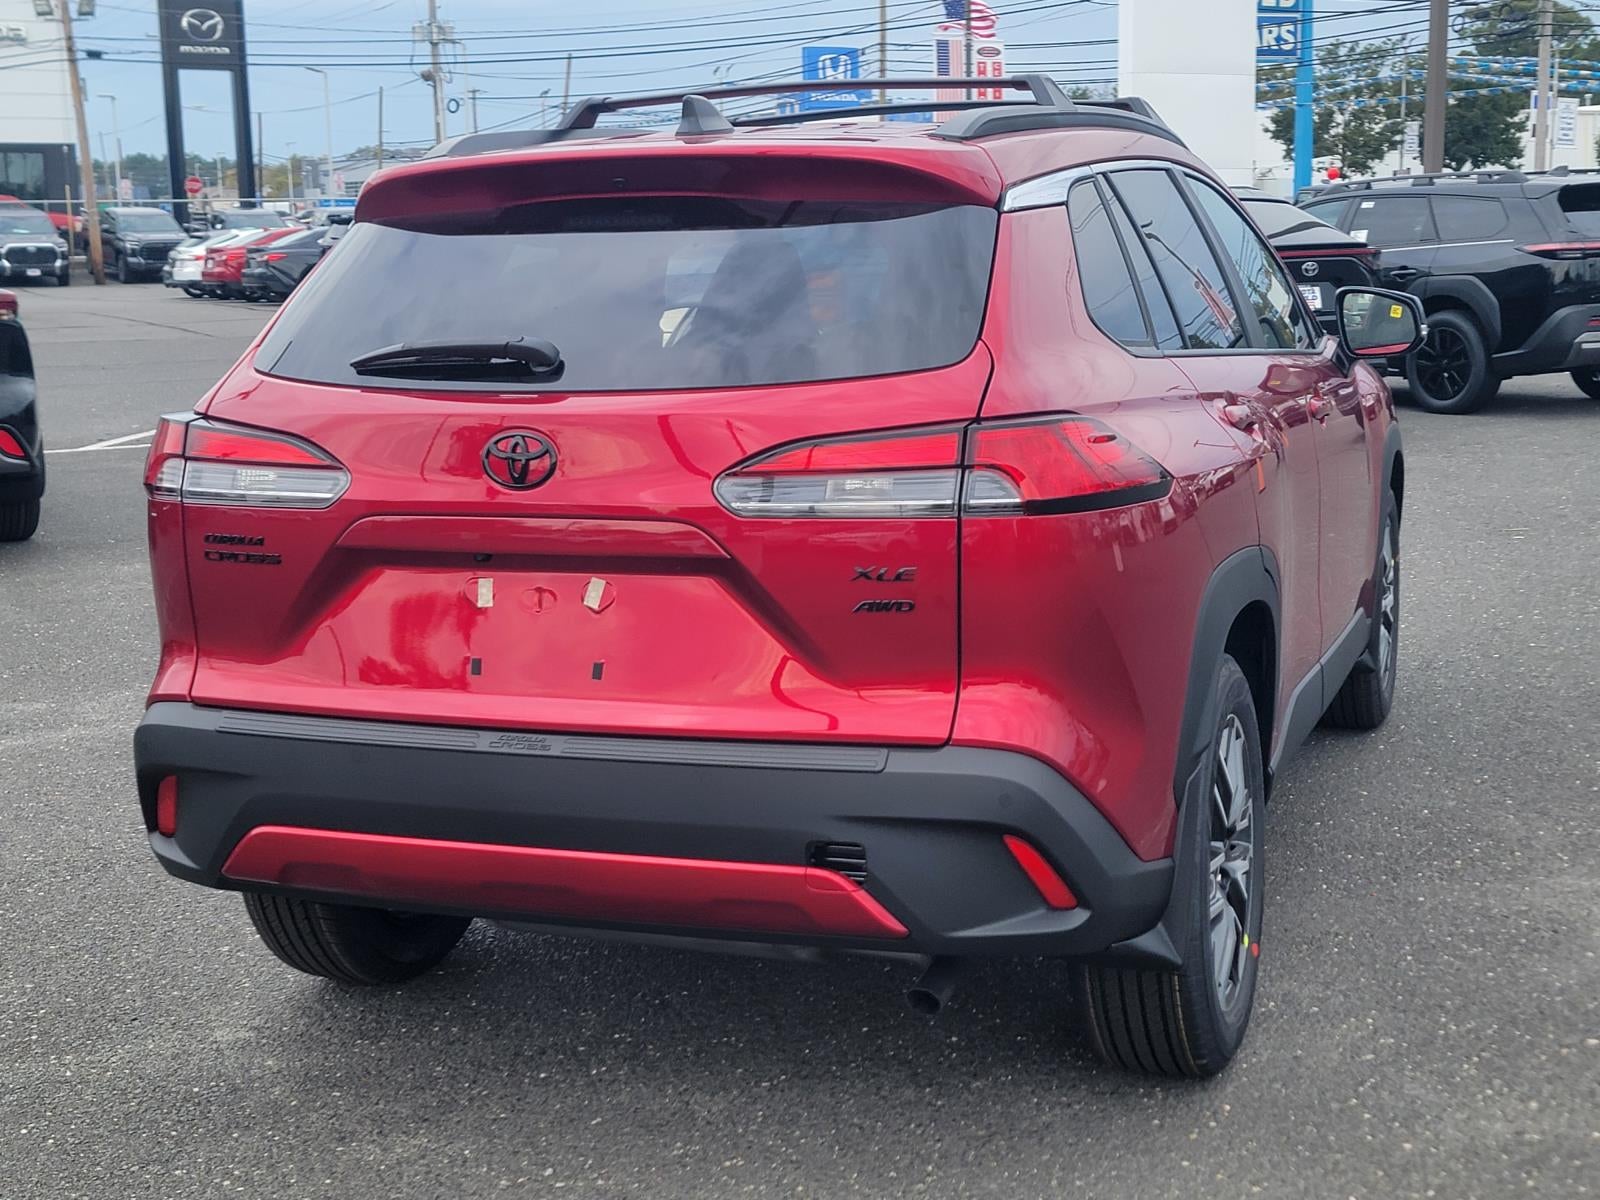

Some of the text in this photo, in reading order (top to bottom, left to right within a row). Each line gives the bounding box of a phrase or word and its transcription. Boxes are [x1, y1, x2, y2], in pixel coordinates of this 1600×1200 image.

[203, 549, 282, 565] CROSS
[851, 566, 917, 582] XLE
[852, 600, 915, 613] AWD
[497, 734, 547, 743] COROLLA
[488, 741, 552, 752] CROSS
